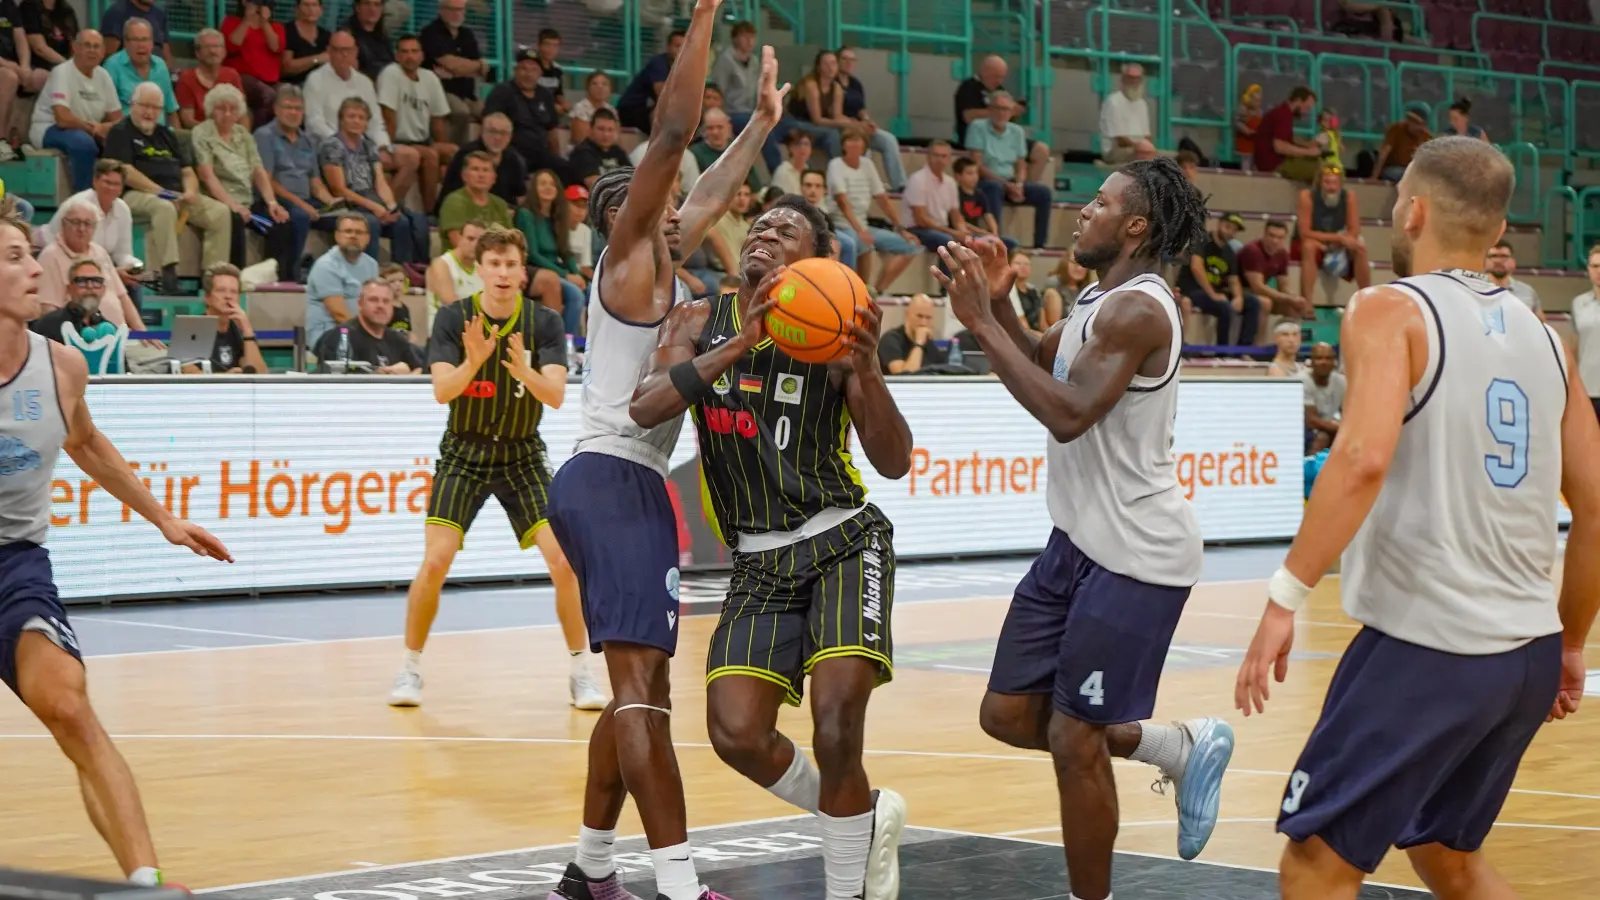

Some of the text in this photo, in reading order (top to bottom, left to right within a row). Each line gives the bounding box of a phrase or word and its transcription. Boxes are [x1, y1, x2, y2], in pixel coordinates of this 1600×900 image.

[12, 389, 42, 421] 15
[514, 378, 526, 399] 3
[703, 404, 758, 438] NKD
[775, 415, 791, 451] 0
[1484, 377, 1529, 488] 9
[908, 441, 1278, 501] Partner geräte
[1078, 670, 1105, 706] 4
[1282, 768, 1310, 814] 9
